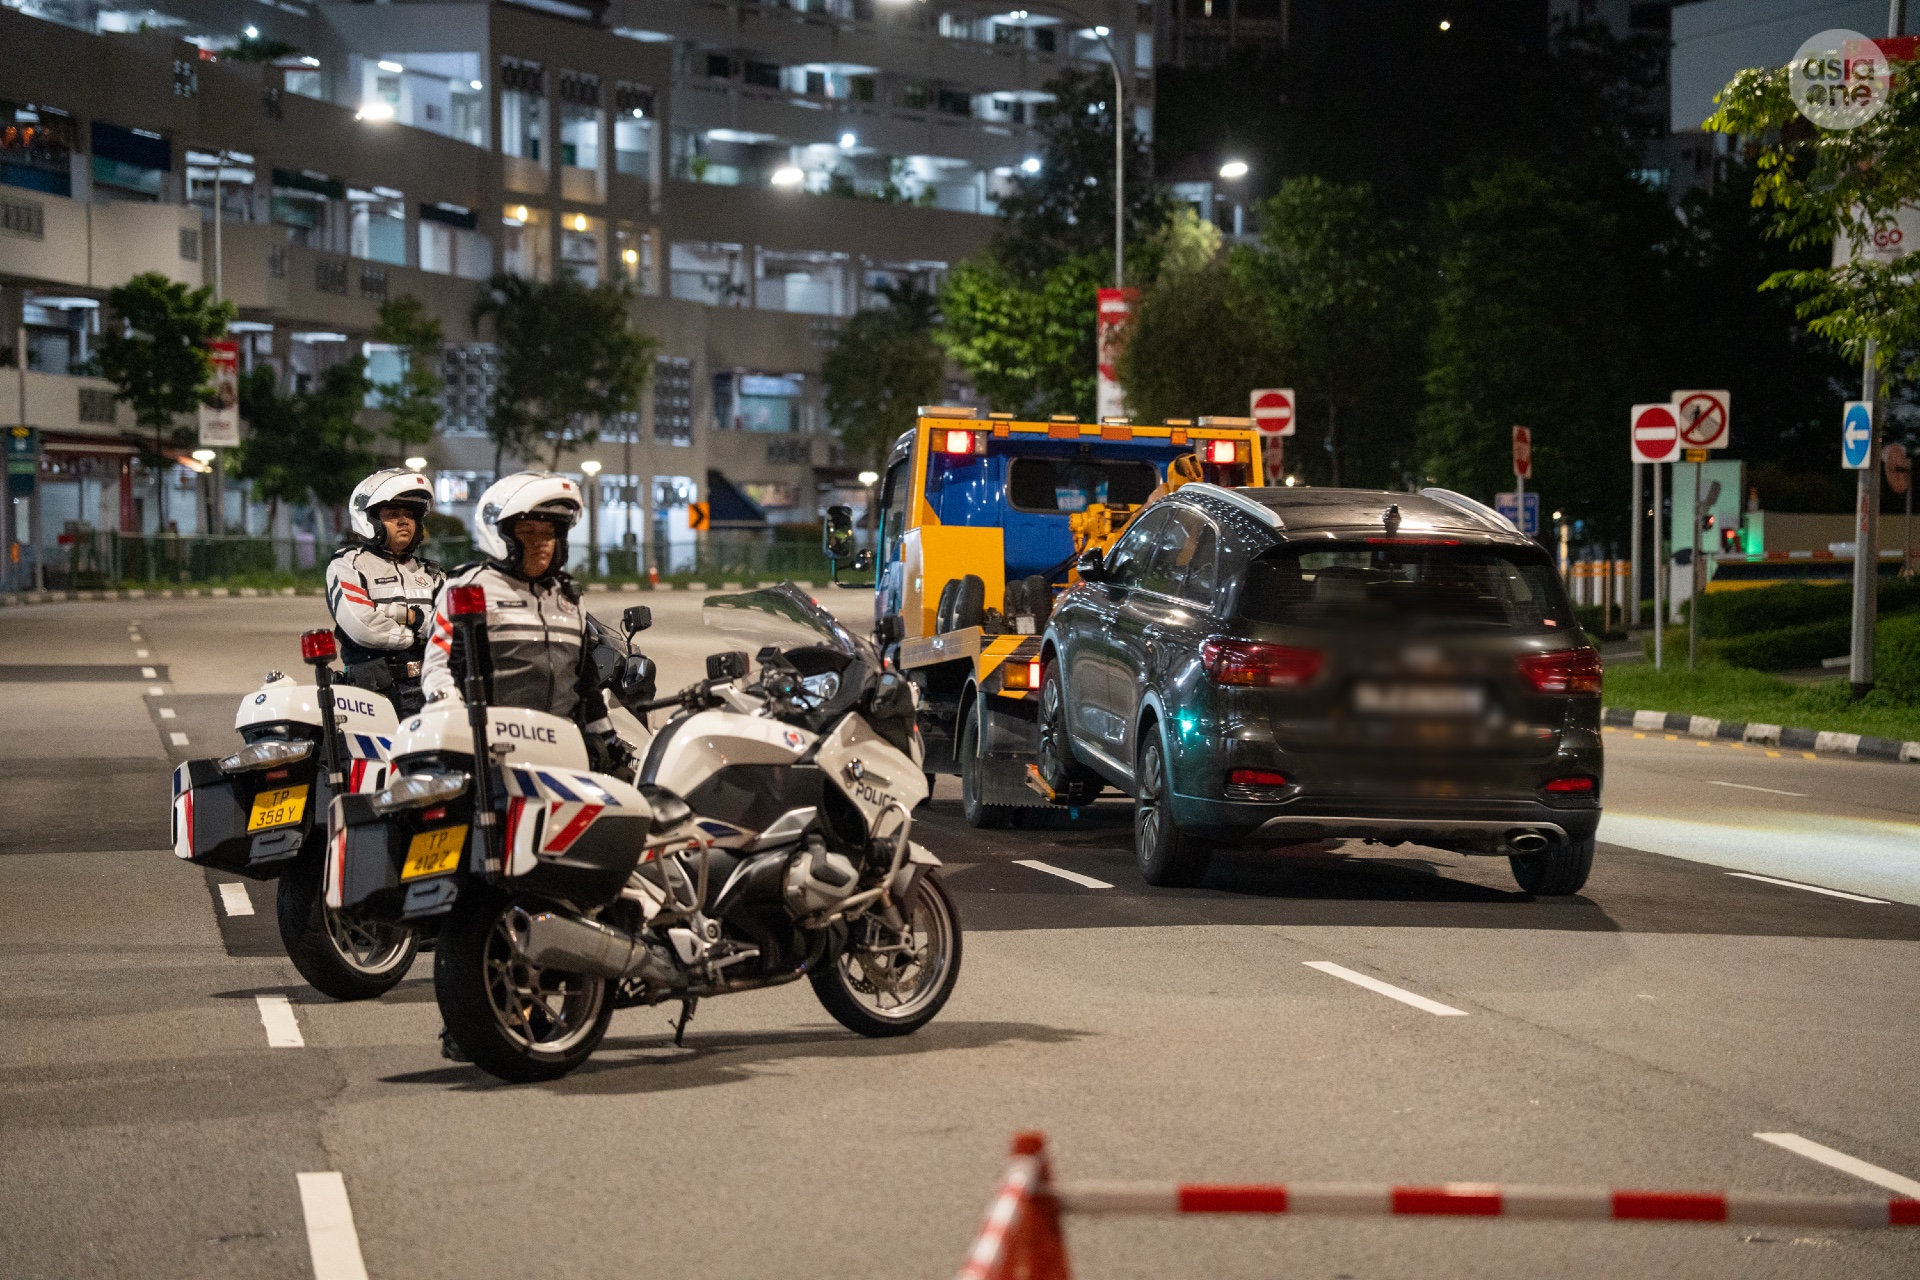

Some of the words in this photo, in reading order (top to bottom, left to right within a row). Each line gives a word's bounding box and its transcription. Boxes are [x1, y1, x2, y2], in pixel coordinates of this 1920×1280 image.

[333, 697, 375, 717] OLICE
[496, 721, 557, 744] POLICE
[272, 790, 290, 807] TP
[429, 832, 448, 850] TP
